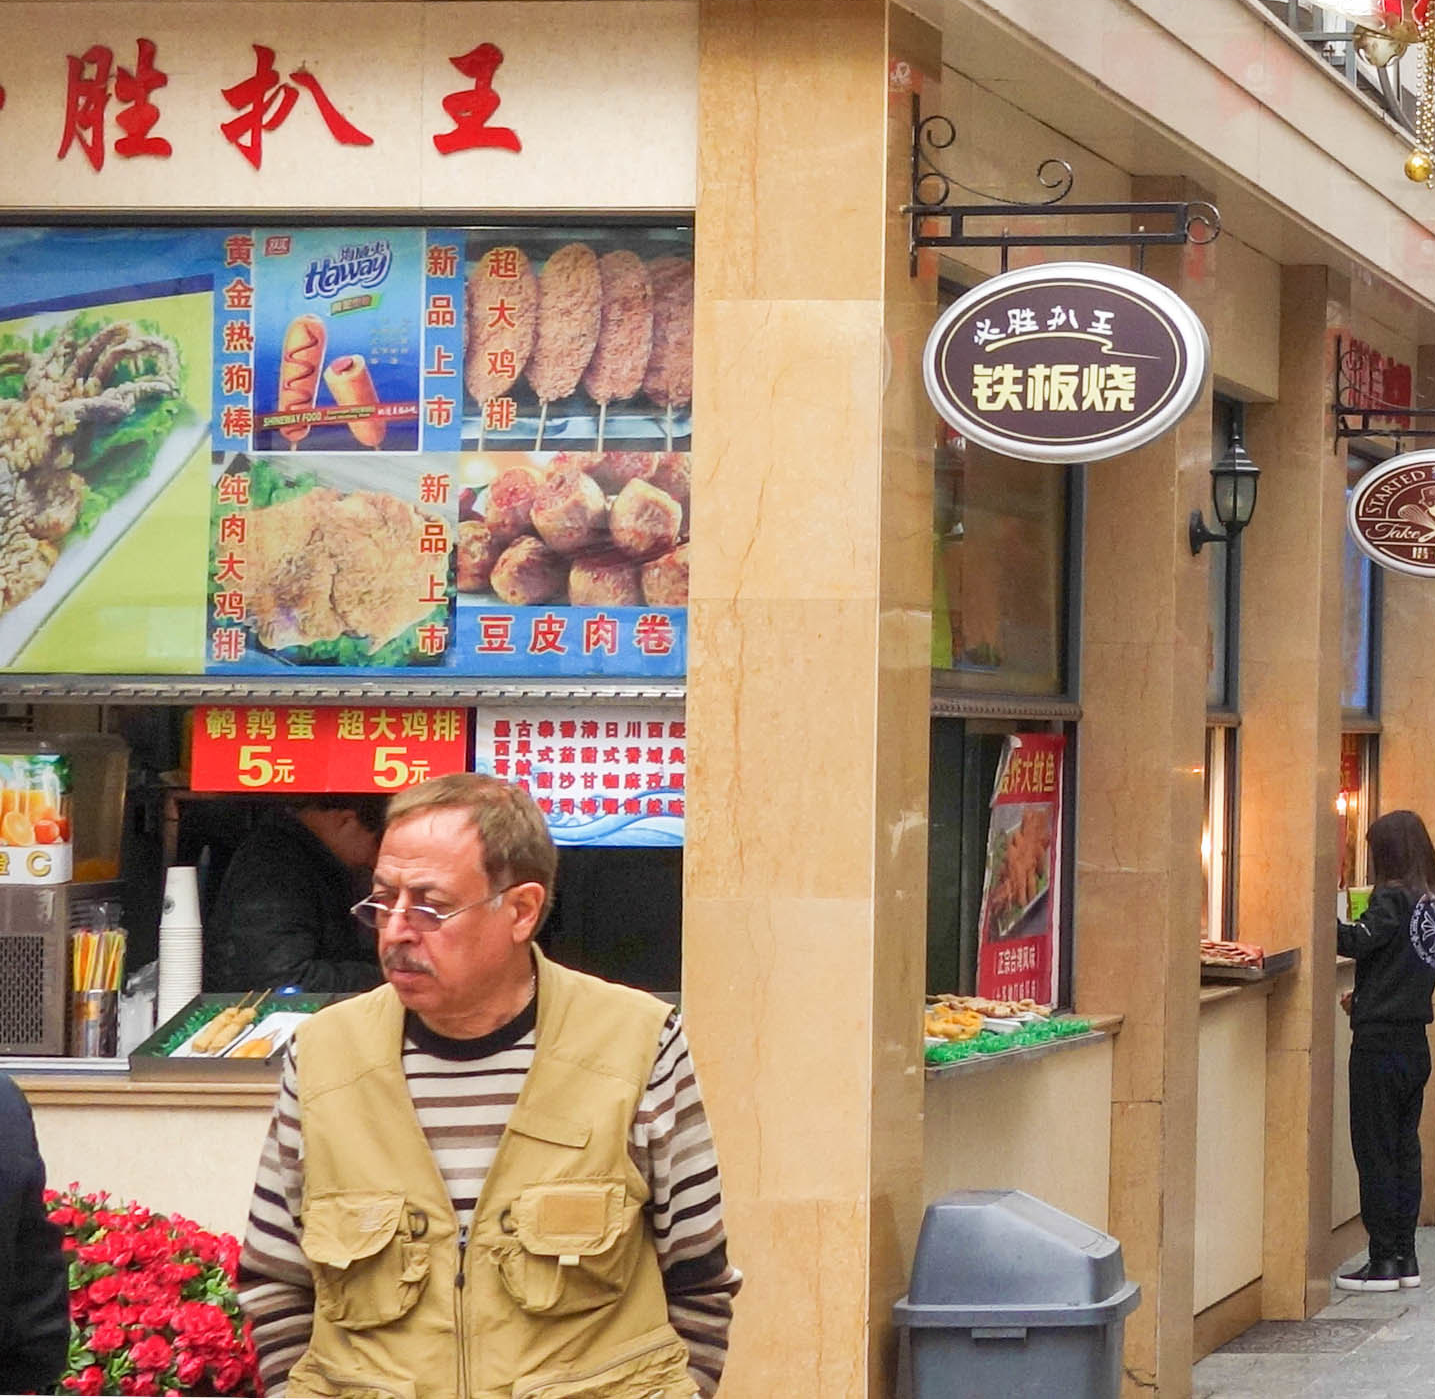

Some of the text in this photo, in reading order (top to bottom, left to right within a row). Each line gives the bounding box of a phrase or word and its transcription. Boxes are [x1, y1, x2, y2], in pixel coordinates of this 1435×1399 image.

[0, 38, 522, 172] 胜扒王
[304, 254, 391, 298] Haway
[222, 236, 255, 439] 黄金热狗棒
[425, 246, 459, 428] 新品上市
[487, 247, 518, 431] 超大鸡排
[973, 304, 1115, 345] 必胜扒王
[971, 363, 1137, 412] 铁板烧
[1365, 469, 1426, 515] STARTED
[1365, 522, 1421, 540] Take
[213, 473, 249, 662] 纯肉大鸡排
[417, 473, 450, 656] 新品上市
[477, 613, 674, 657] 豆皮肉卷
[206, 707, 462, 743] 鹌鹑蛋 超大鸡排
[237, 744, 296, 788] 5元
[372, 745, 432, 789] 5元
